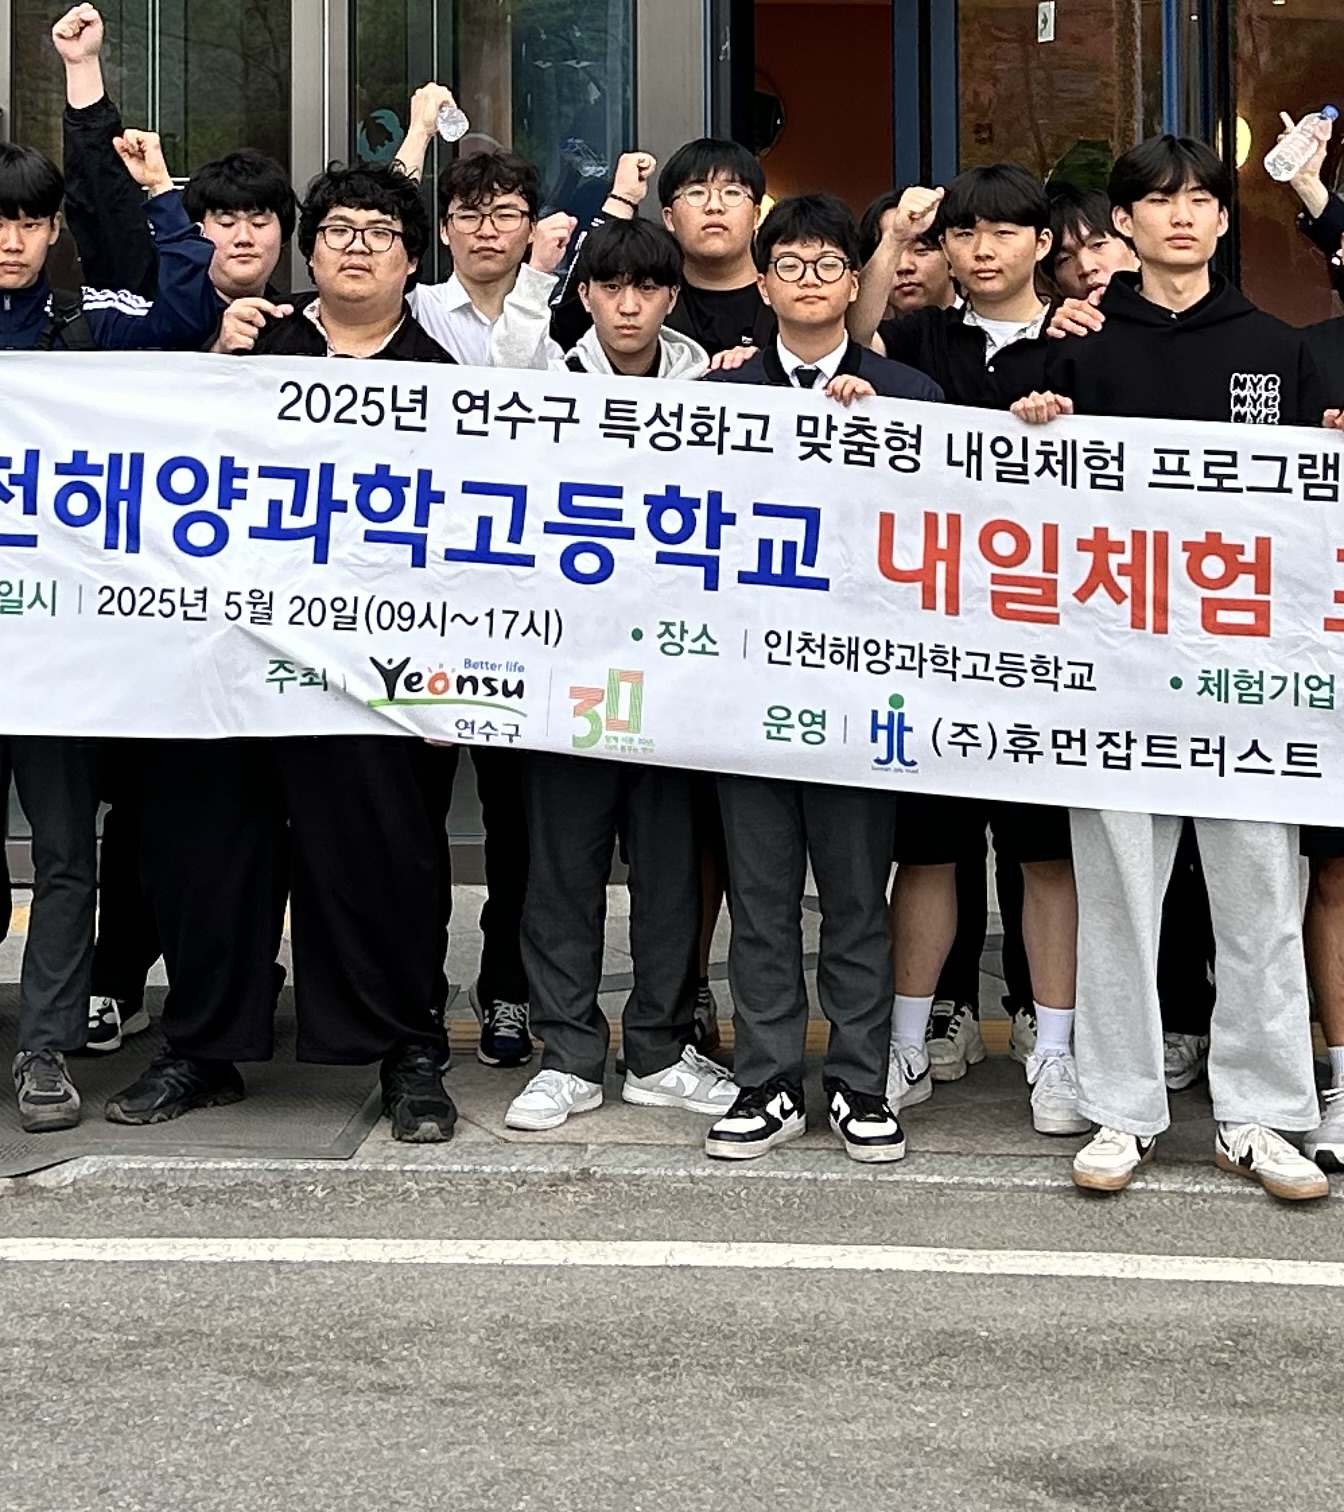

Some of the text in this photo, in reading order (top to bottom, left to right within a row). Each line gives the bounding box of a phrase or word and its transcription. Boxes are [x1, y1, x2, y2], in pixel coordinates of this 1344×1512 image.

[277, 380, 1340, 503] 2025년 연수구 특성화고 맞춤형 내일체험 프로그램
[877, 510, 1272, 638] 내일체험
[97, 585, 208, 622] 2025년
[224, 588, 274, 626] 5월
[287, 594, 563, 648] 20일(09시~17시)
[264, 659, 328, 694] 주최
[369, 655, 525, 702] Yeonsu
[463, 657, 525, 673] Better life
[656, 620, 1097, 695] 장소 인천해양과학고등학교
[1197, 668, 1336, 711] 체험기업
[454, 718, 522, 744] 연수구
[762, 705, 1322, 779] 운영 (주)휴먼잡트러스트
